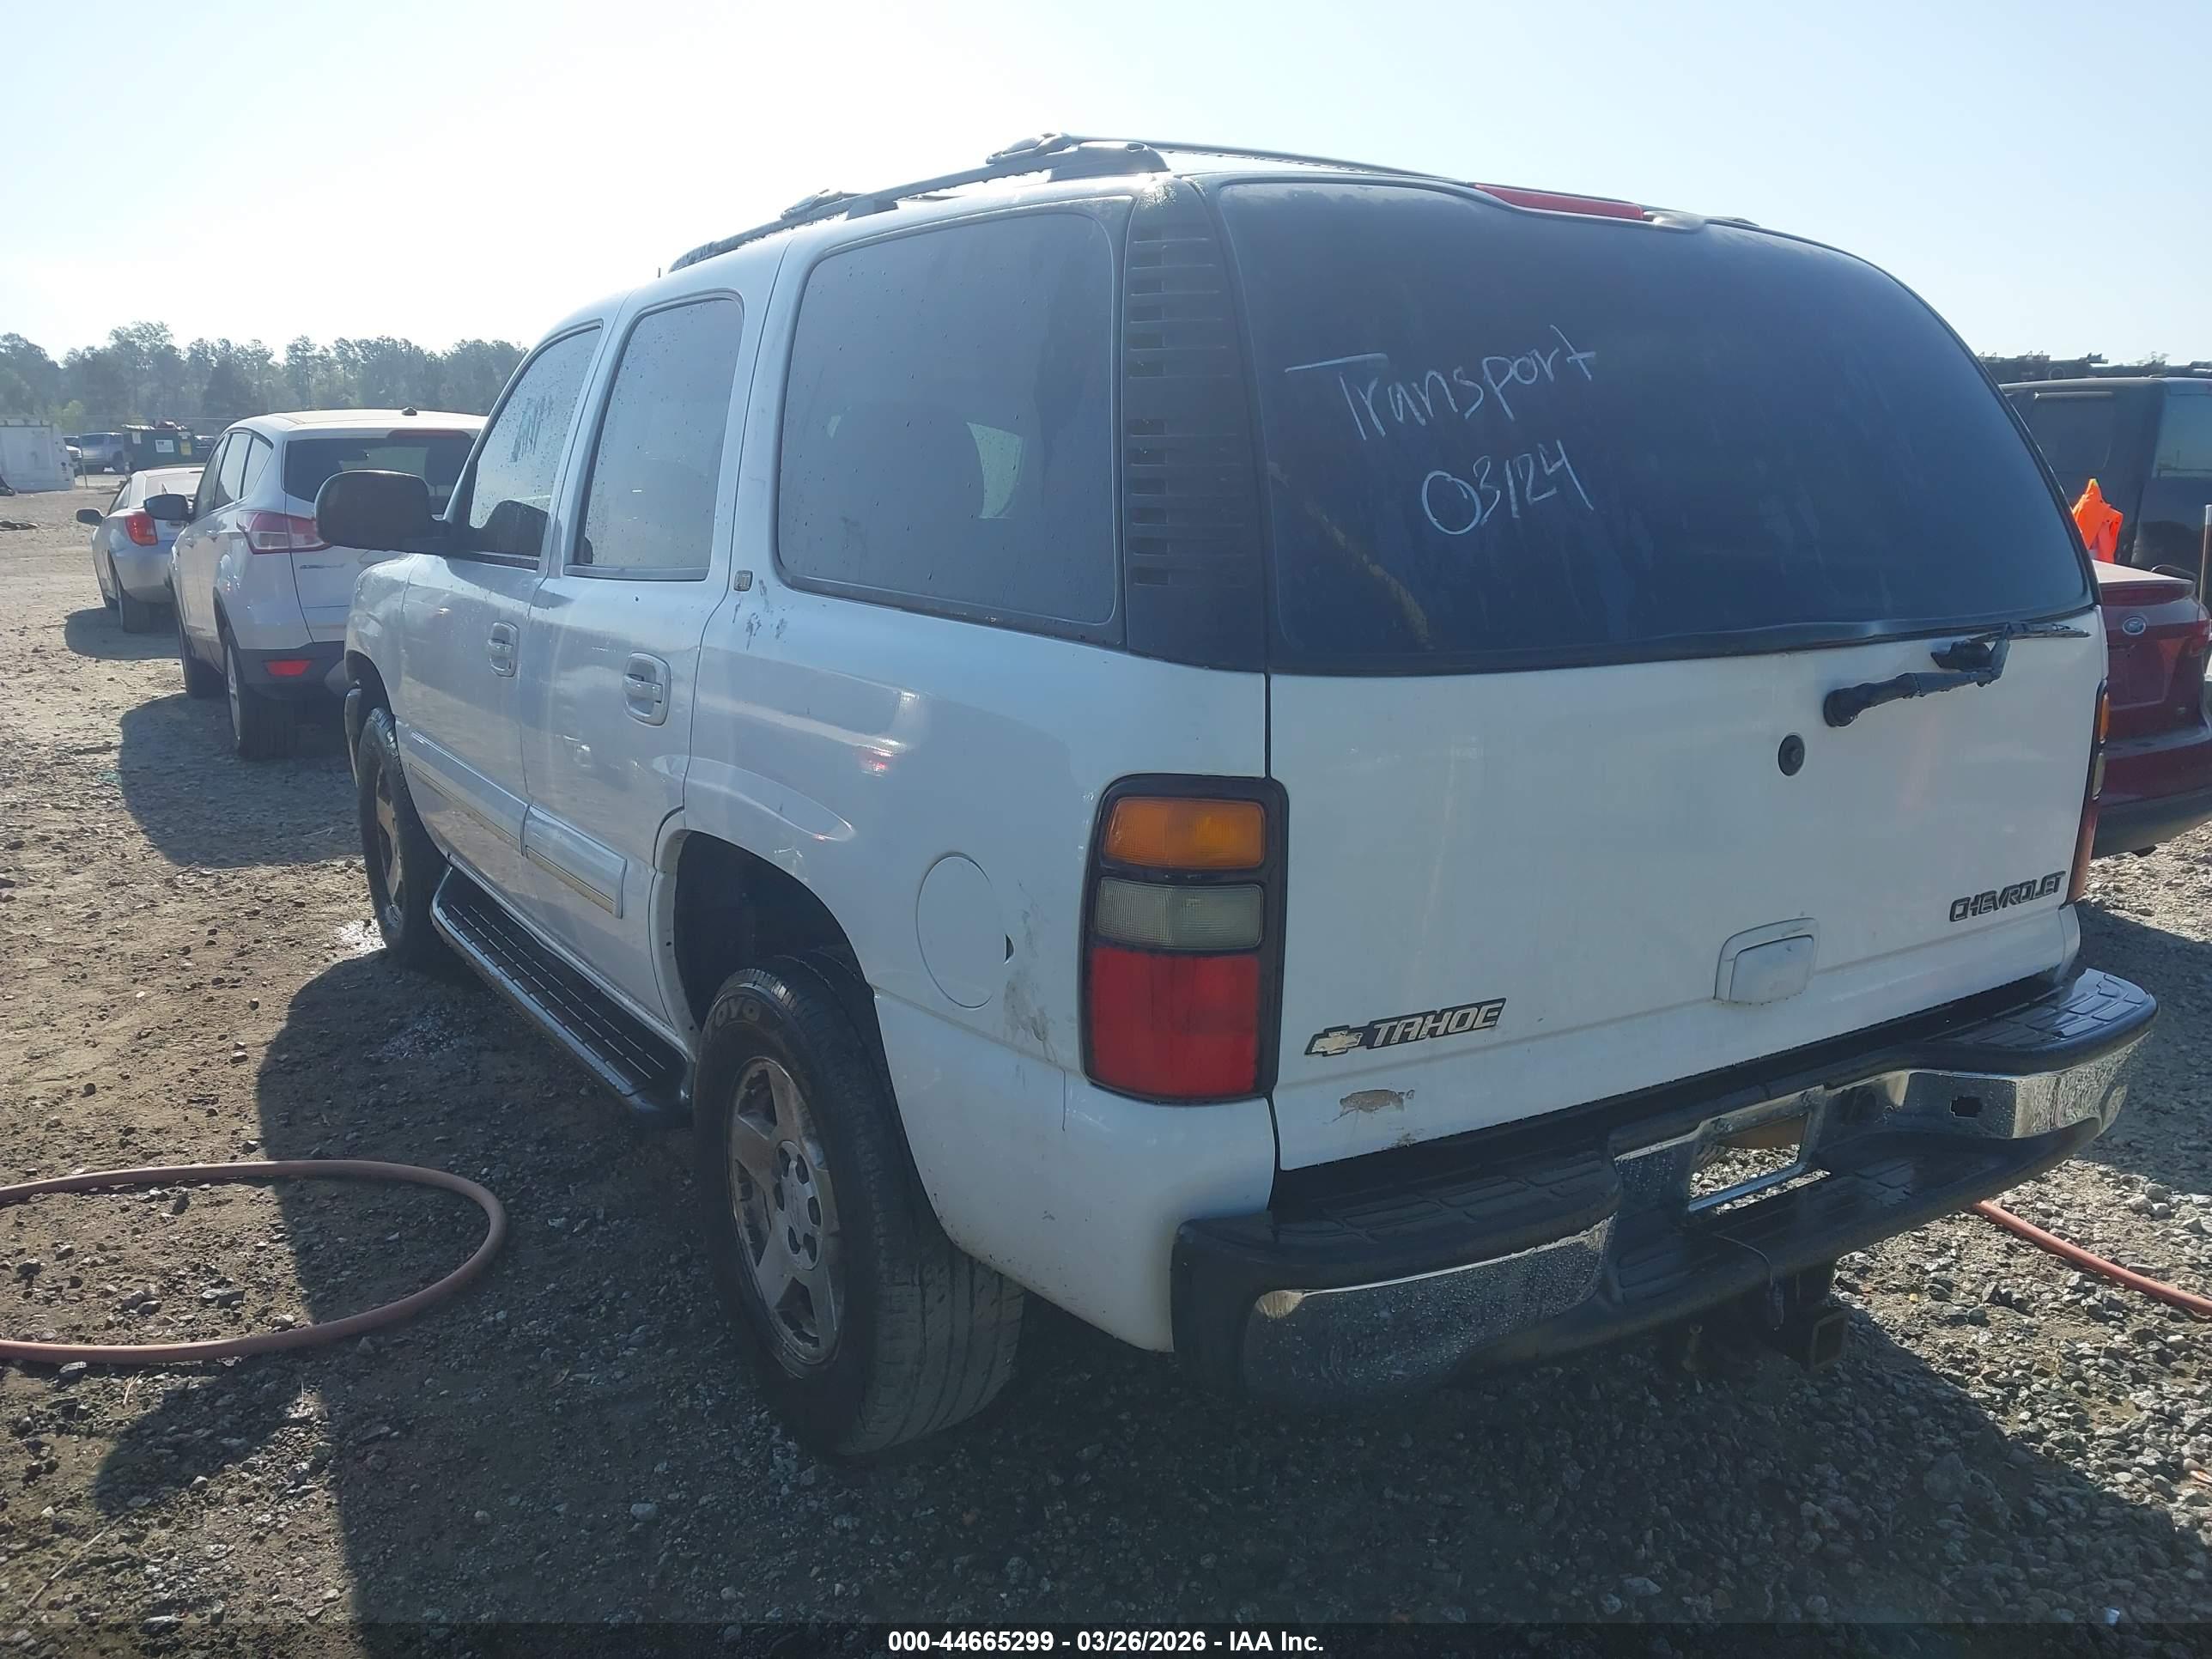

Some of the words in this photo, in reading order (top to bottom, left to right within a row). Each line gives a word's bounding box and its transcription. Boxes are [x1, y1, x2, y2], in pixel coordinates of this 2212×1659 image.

[1285, 325, 1596, 441] Transport
[1948, 870, 2066, 922] CHEVROLET
[1372, 1001, 1505, 1048] TAHOE
